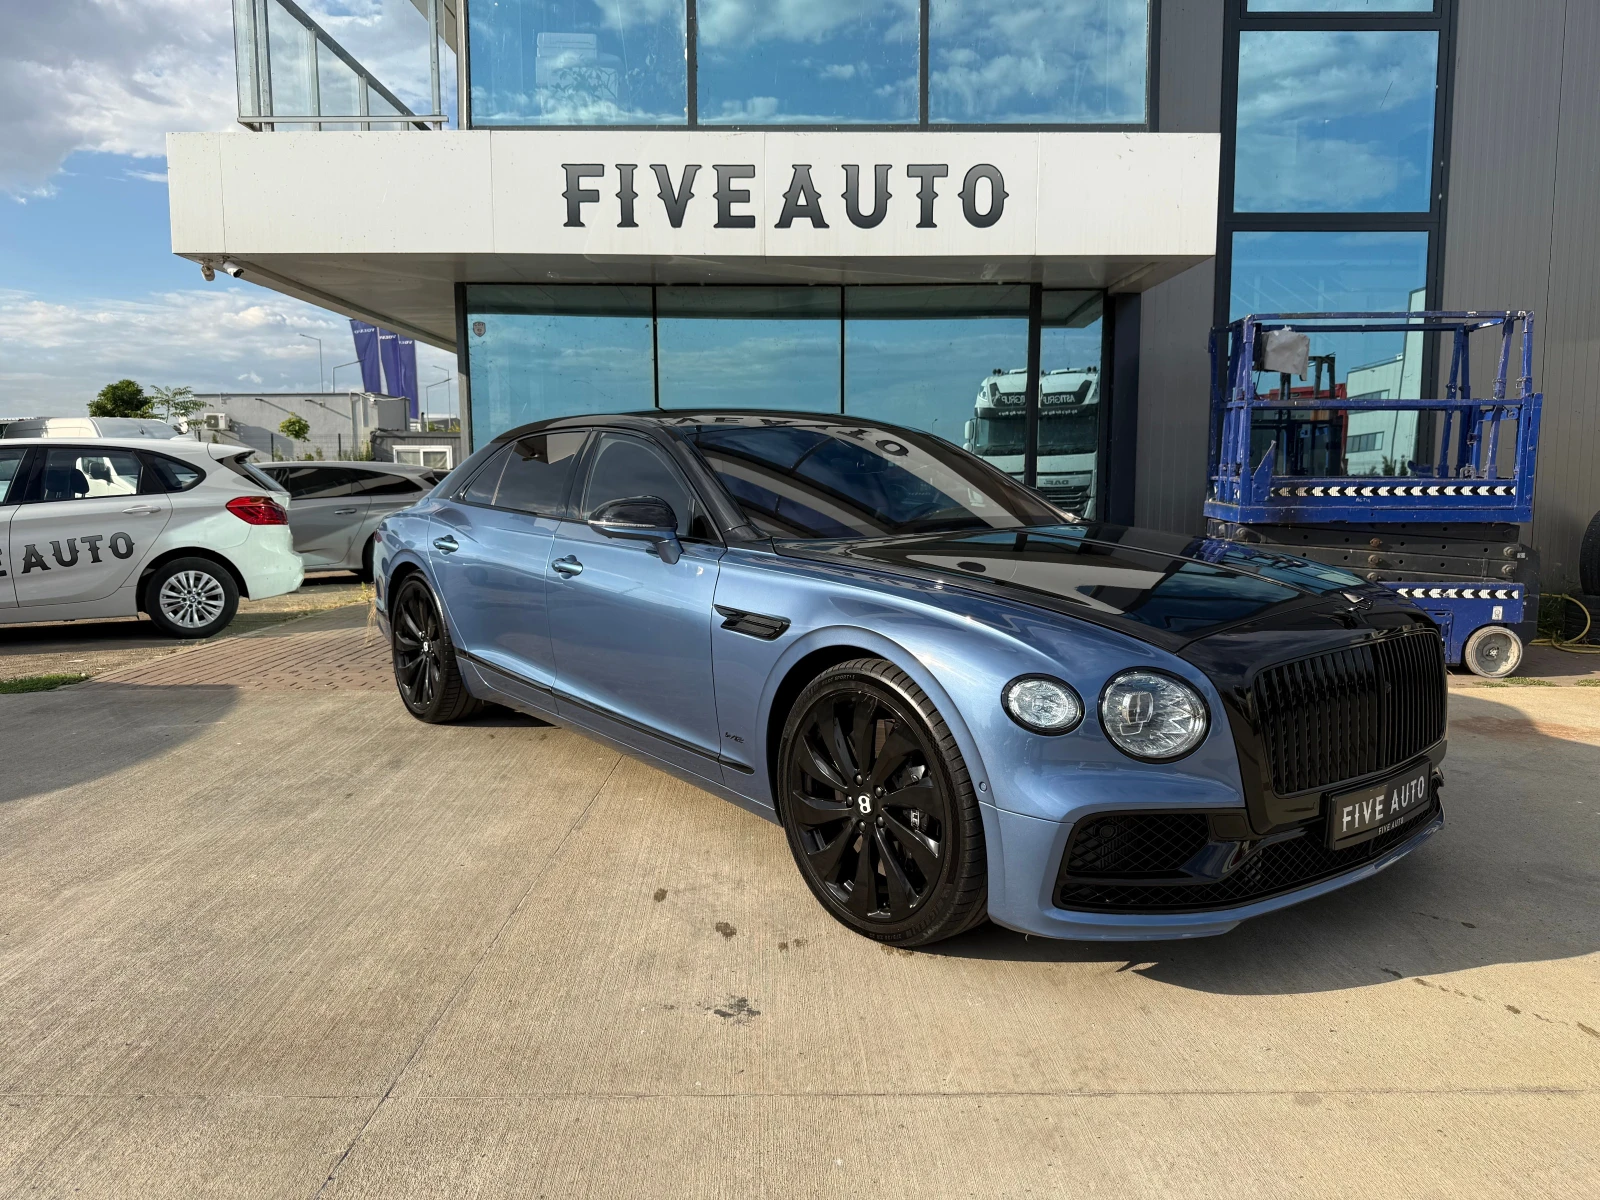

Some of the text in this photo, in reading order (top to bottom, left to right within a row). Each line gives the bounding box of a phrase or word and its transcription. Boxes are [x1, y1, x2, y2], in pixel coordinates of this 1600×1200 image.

[561, 163, 1009, 229] FIVE AUTO
[21, 531, 135, 574] AUTO
[1342, 776, 1425, 832] FIVE AUTO
